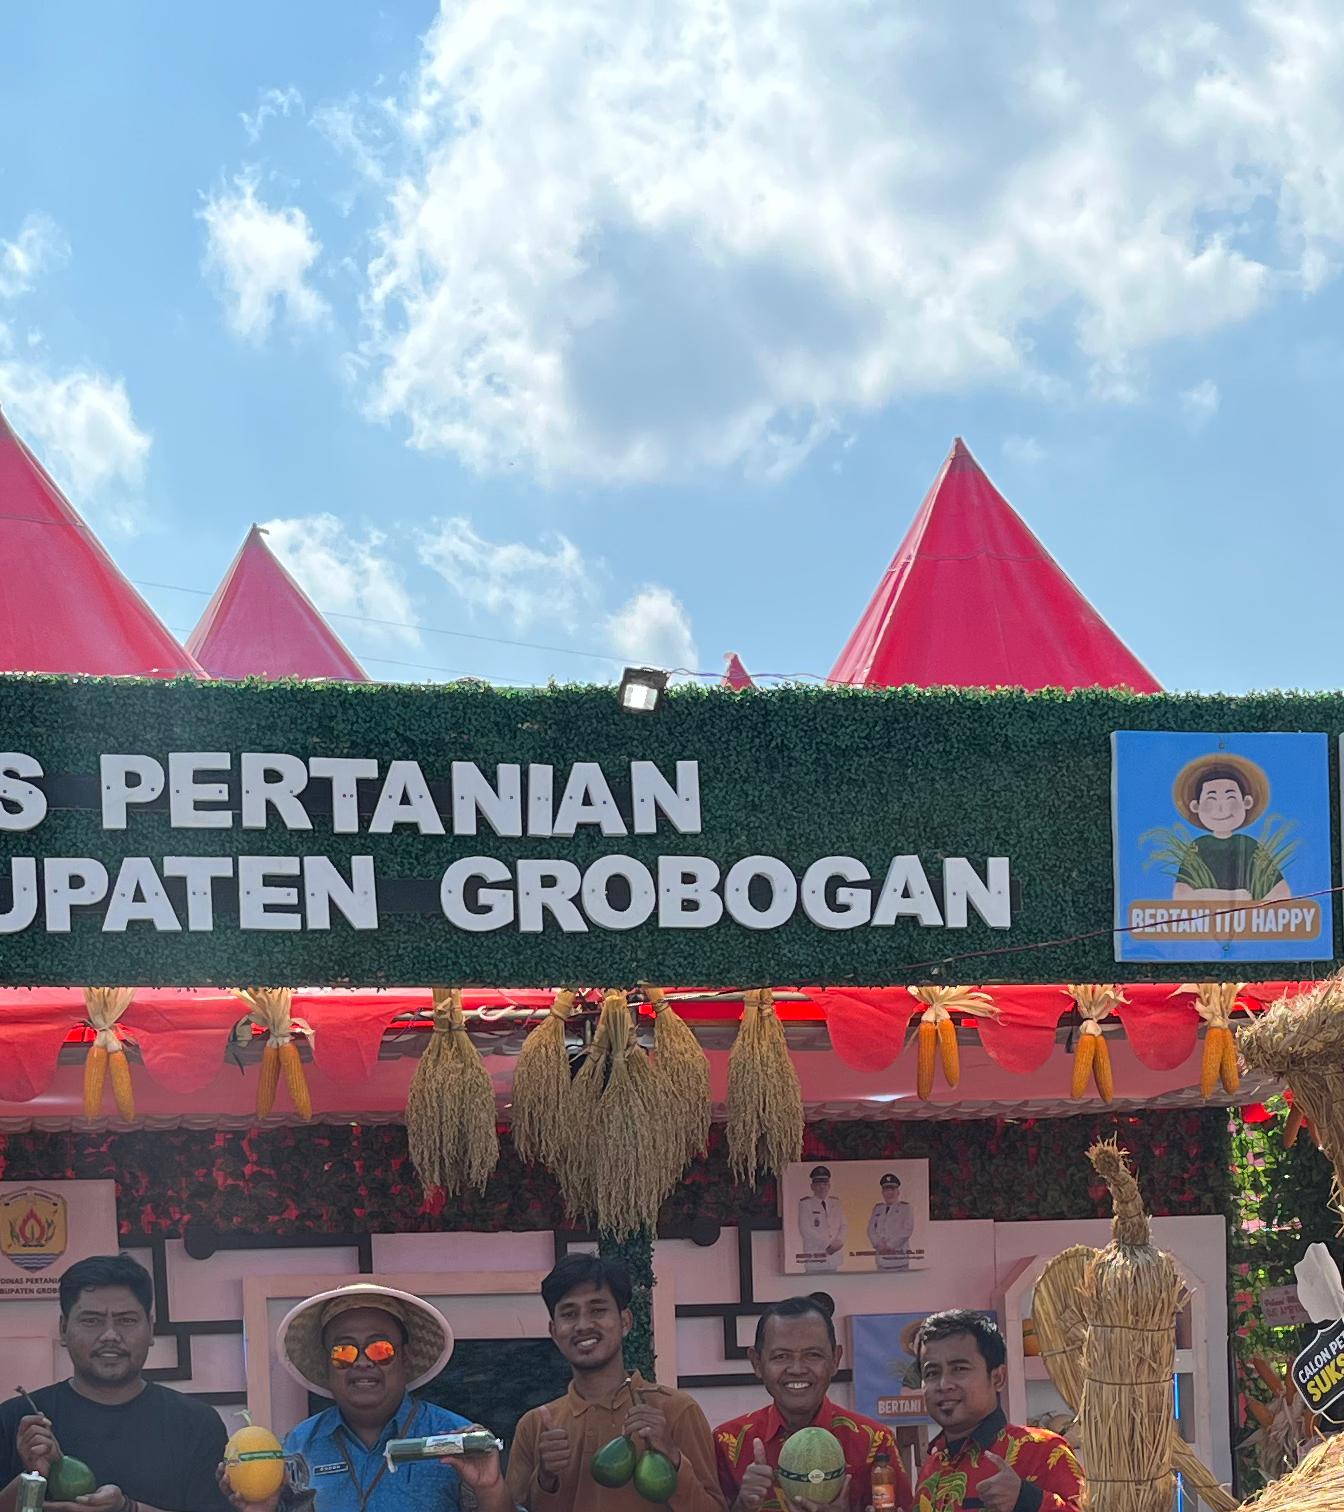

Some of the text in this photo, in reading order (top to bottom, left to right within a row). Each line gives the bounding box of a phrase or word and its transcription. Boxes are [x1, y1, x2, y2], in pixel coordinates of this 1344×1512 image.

[100, 751, 702, 837] PERTANIAN
[440, 853, 1012, 934] GROBOGAN
[1131, 907, 1316, 933] BERTANI ITU HAPPY
[0, 1277, 24, 1285] DINAS
[1298, 1348, 1332, 1384] CALON
[878, 1399, 921, 1414] BERTANI
